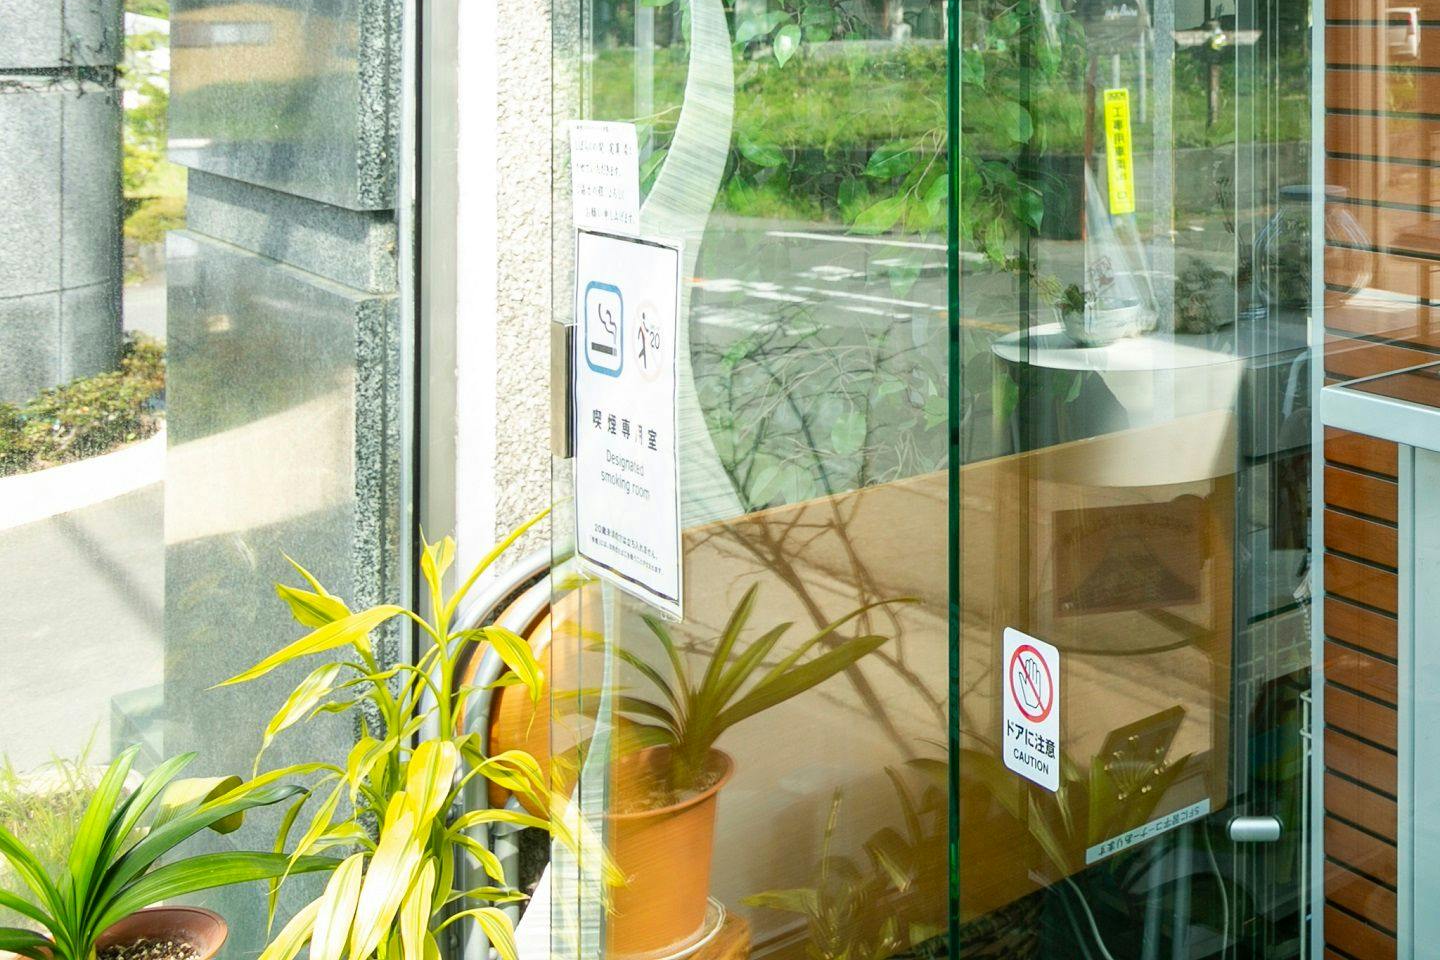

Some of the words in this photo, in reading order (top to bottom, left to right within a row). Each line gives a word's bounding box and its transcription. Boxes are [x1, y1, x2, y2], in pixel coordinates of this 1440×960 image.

[606, 449, 645, 477] Designated
[601, 471, 631, 495] smoking
[632, 483, 651, 501] room
[1007, 719, 1056, 759] ドアに注意
[1013, 748, 1049, 775] CAUTION
